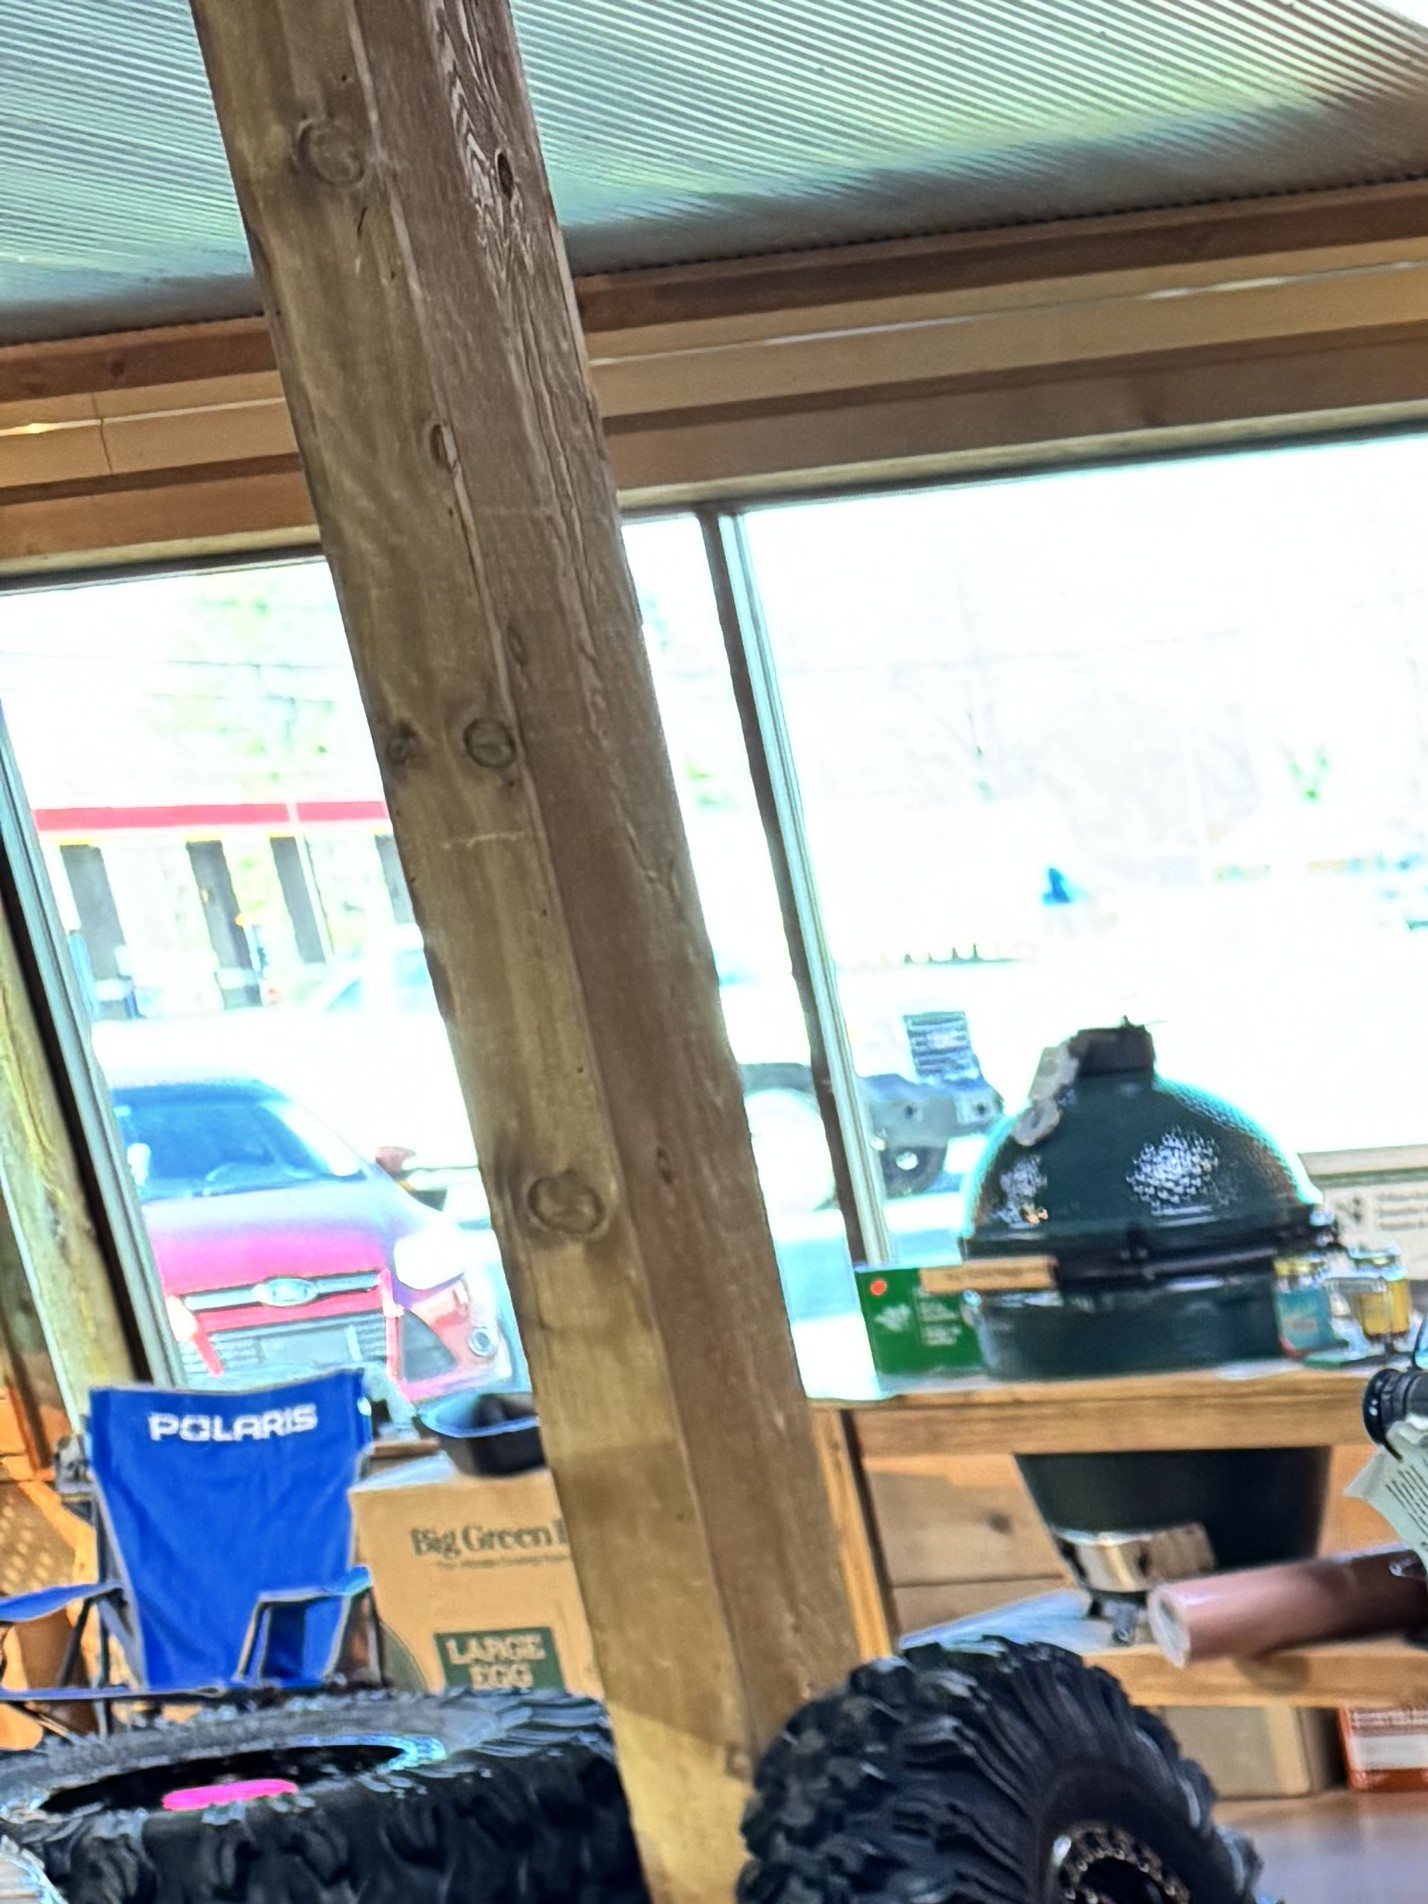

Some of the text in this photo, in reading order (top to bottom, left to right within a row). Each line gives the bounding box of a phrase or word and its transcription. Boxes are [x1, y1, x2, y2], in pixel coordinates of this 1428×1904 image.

[148, 1402, 318, 1442] POLARIS
[410, 1526, 461, 1559] Big
[461, 1524, 552, 1552] Green
[444, 1633, 547, 1665] LARGE
[469, 1662, 534, 1692] EGG
